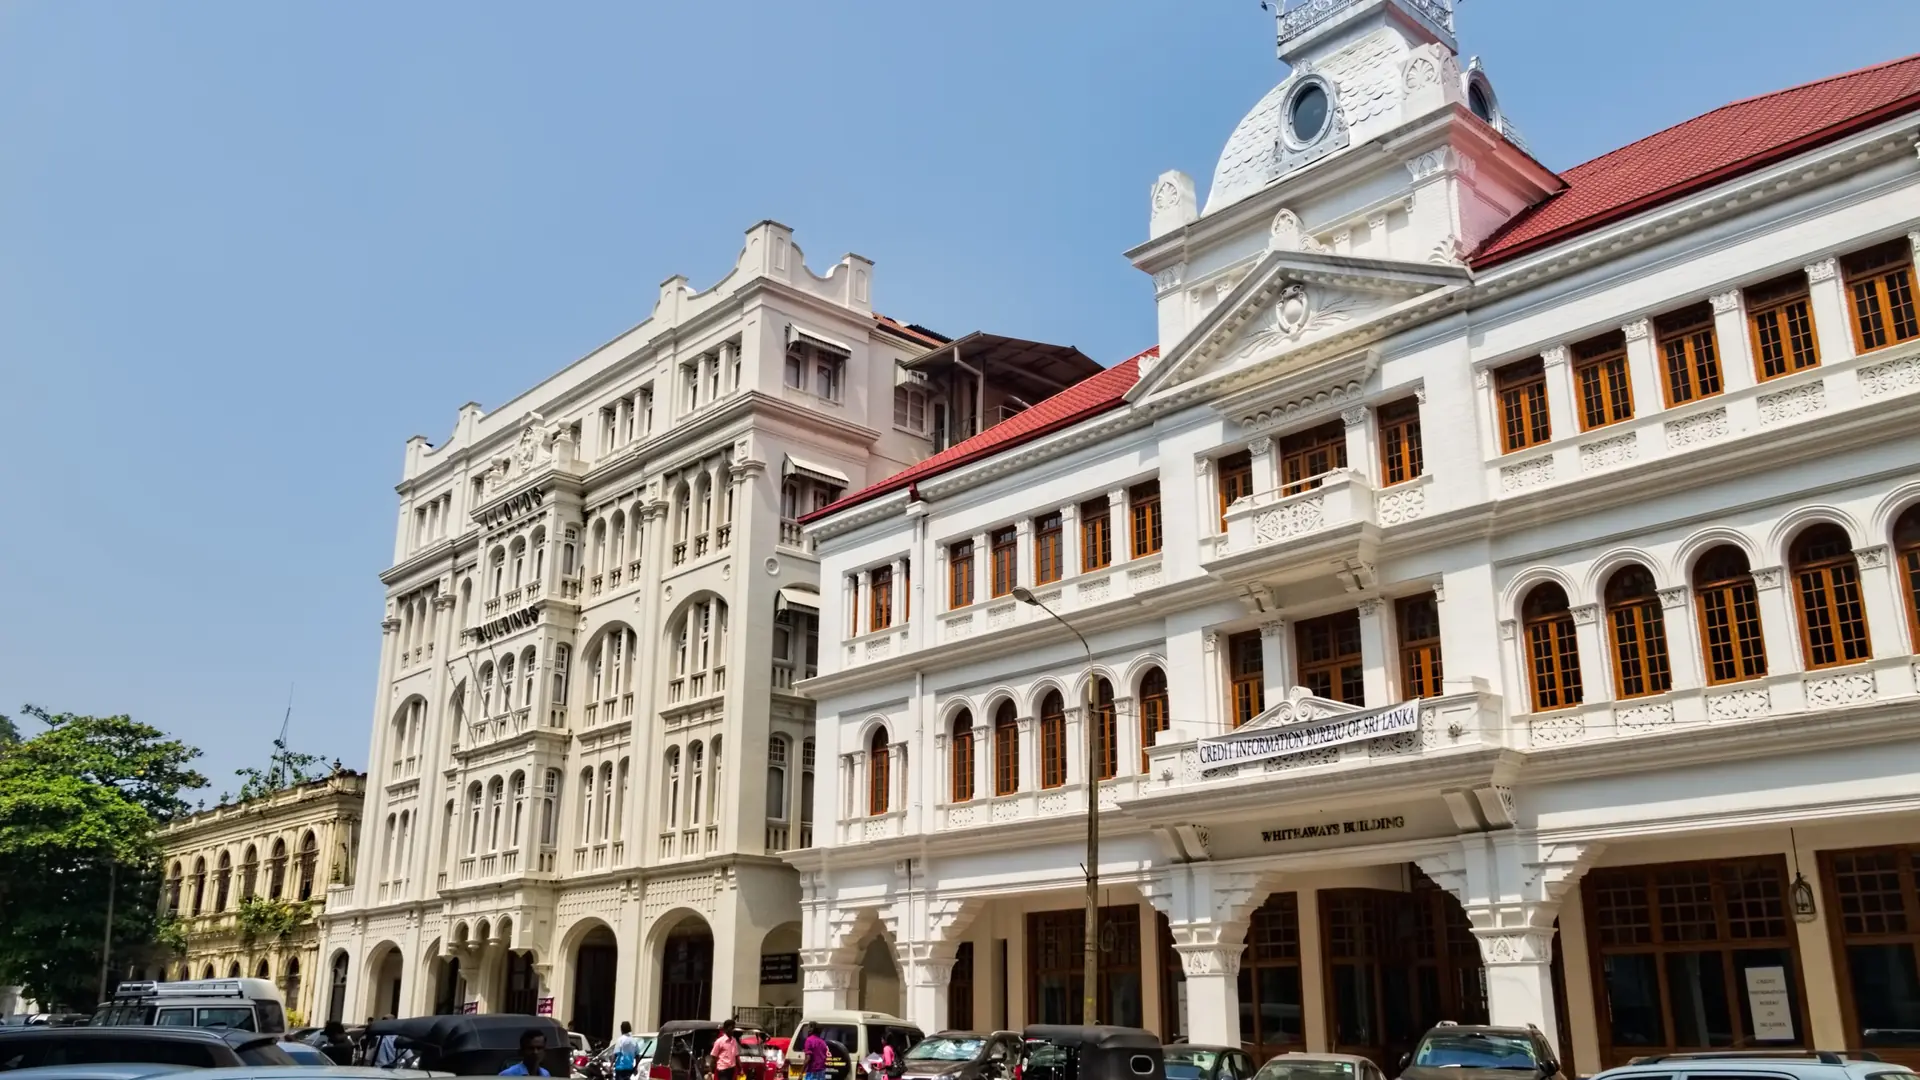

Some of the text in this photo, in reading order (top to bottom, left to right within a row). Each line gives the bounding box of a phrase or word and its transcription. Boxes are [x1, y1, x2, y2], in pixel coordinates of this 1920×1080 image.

[475, 605, 540, 645] BUILDINGS
[1199, 706, 1416, 764] CREDIT INFORMATION BUREAU OF SRI LANKA
[1343, 815, 1405, 834] BUILDING
